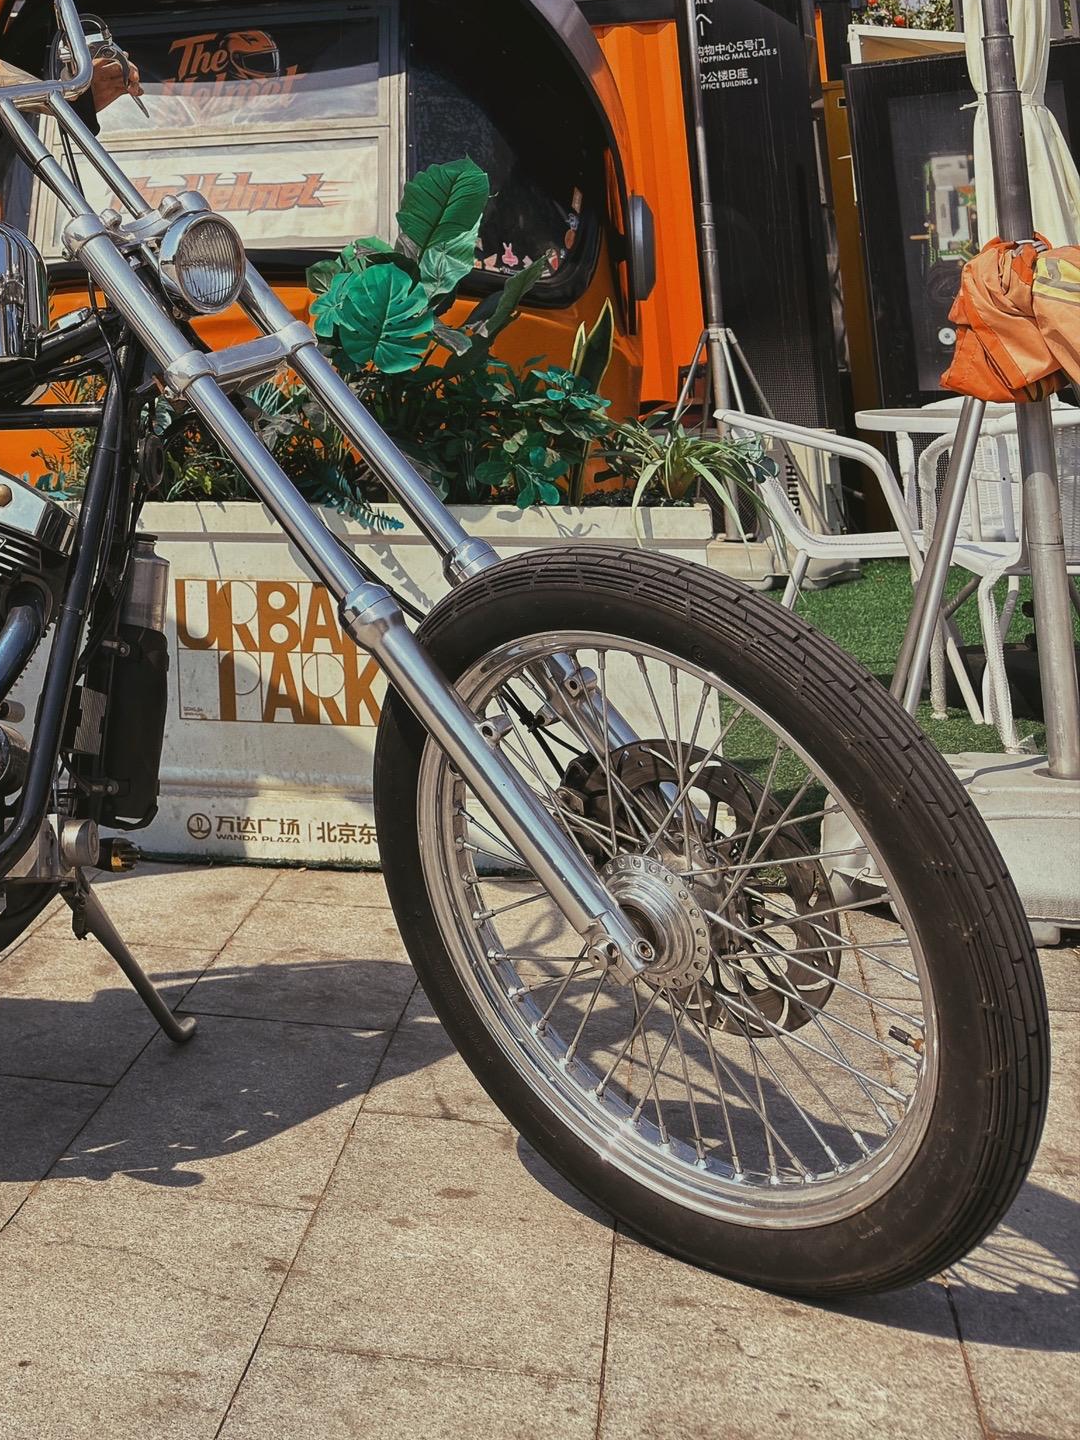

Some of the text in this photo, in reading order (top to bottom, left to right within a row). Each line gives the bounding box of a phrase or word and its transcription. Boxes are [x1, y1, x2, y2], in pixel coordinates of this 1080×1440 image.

[169, 33, 229, 81] The
[699, 54, 730, 64] OPPING
[732, 52, 751, 60] MALL
[752, 49, 771, 57] GATE
[160, 65, 307, 110] Helmet
[700, 83, 720, 91] FFICE
[721, 78, 752, 88] BUILDING
[174, 172, 325, 216] Helmet
[220, 651, 382, 727] PARK
[215, 816, 300, 835] 万达广场
[216, 833, 301, 843] WANDA PLAZA
